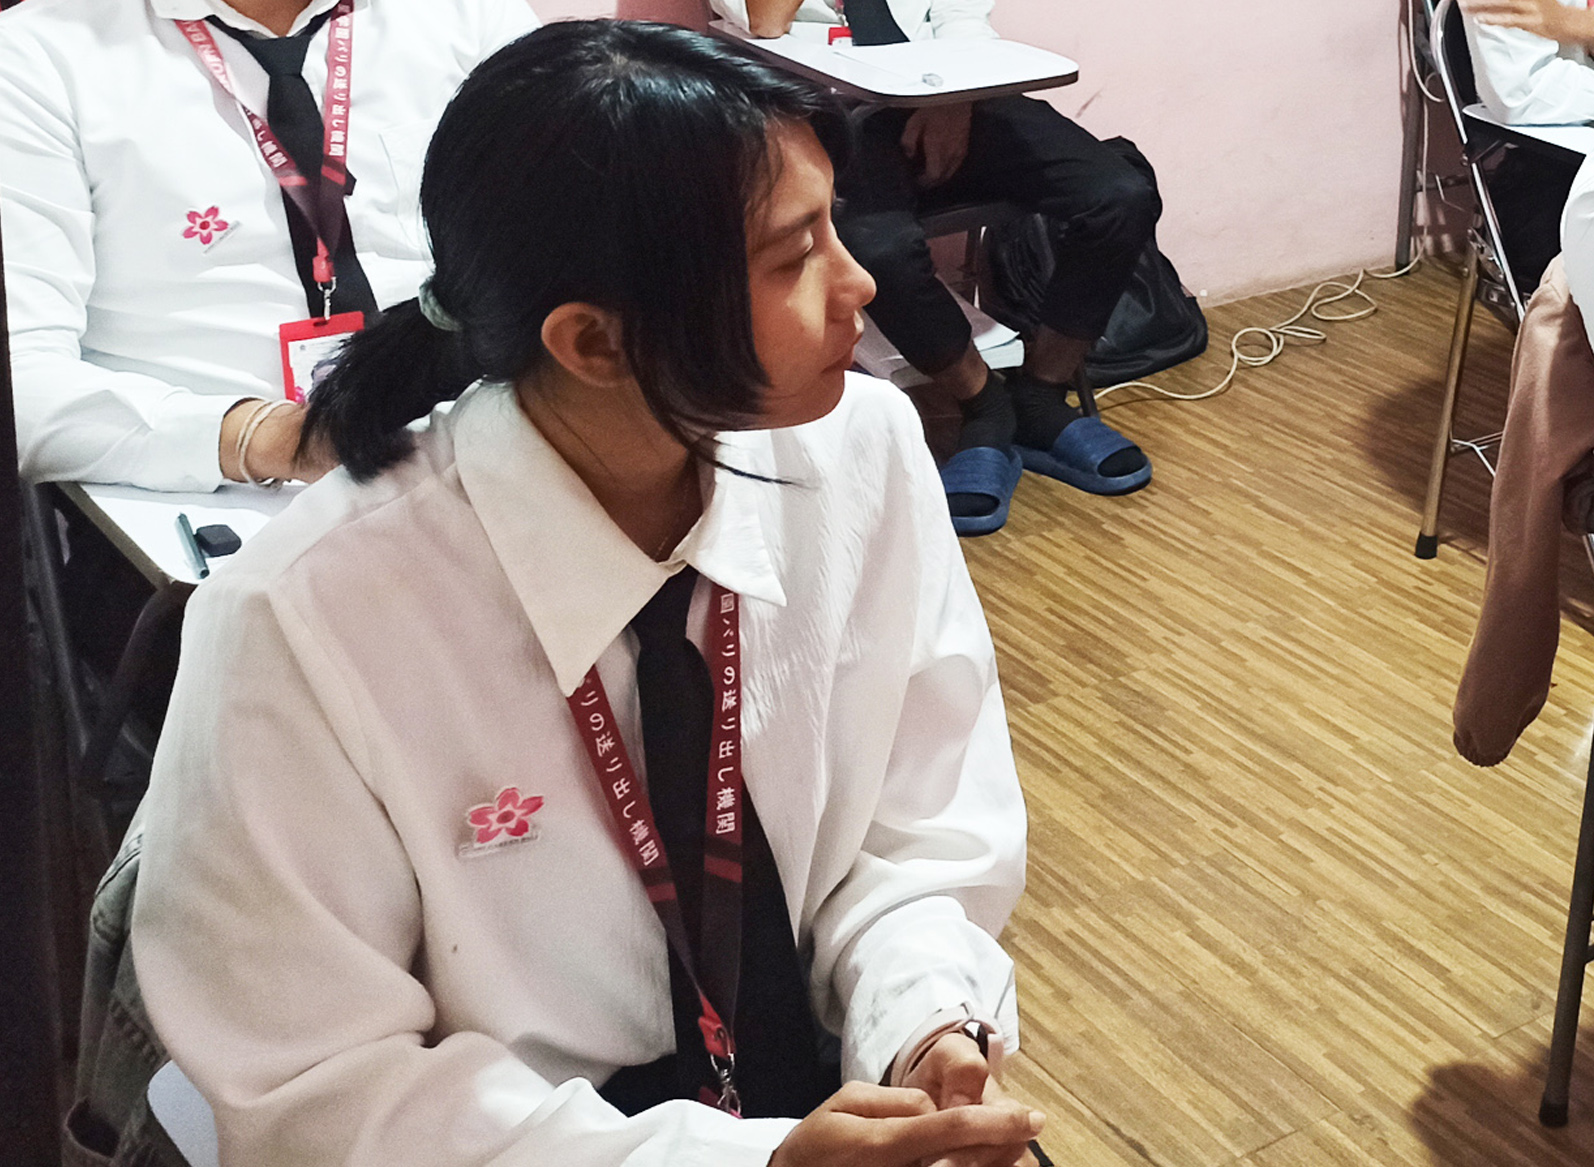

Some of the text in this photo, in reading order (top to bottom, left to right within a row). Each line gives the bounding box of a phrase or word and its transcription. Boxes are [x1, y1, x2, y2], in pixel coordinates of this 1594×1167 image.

[580, 679, 661, 867] リの送り出し機関
